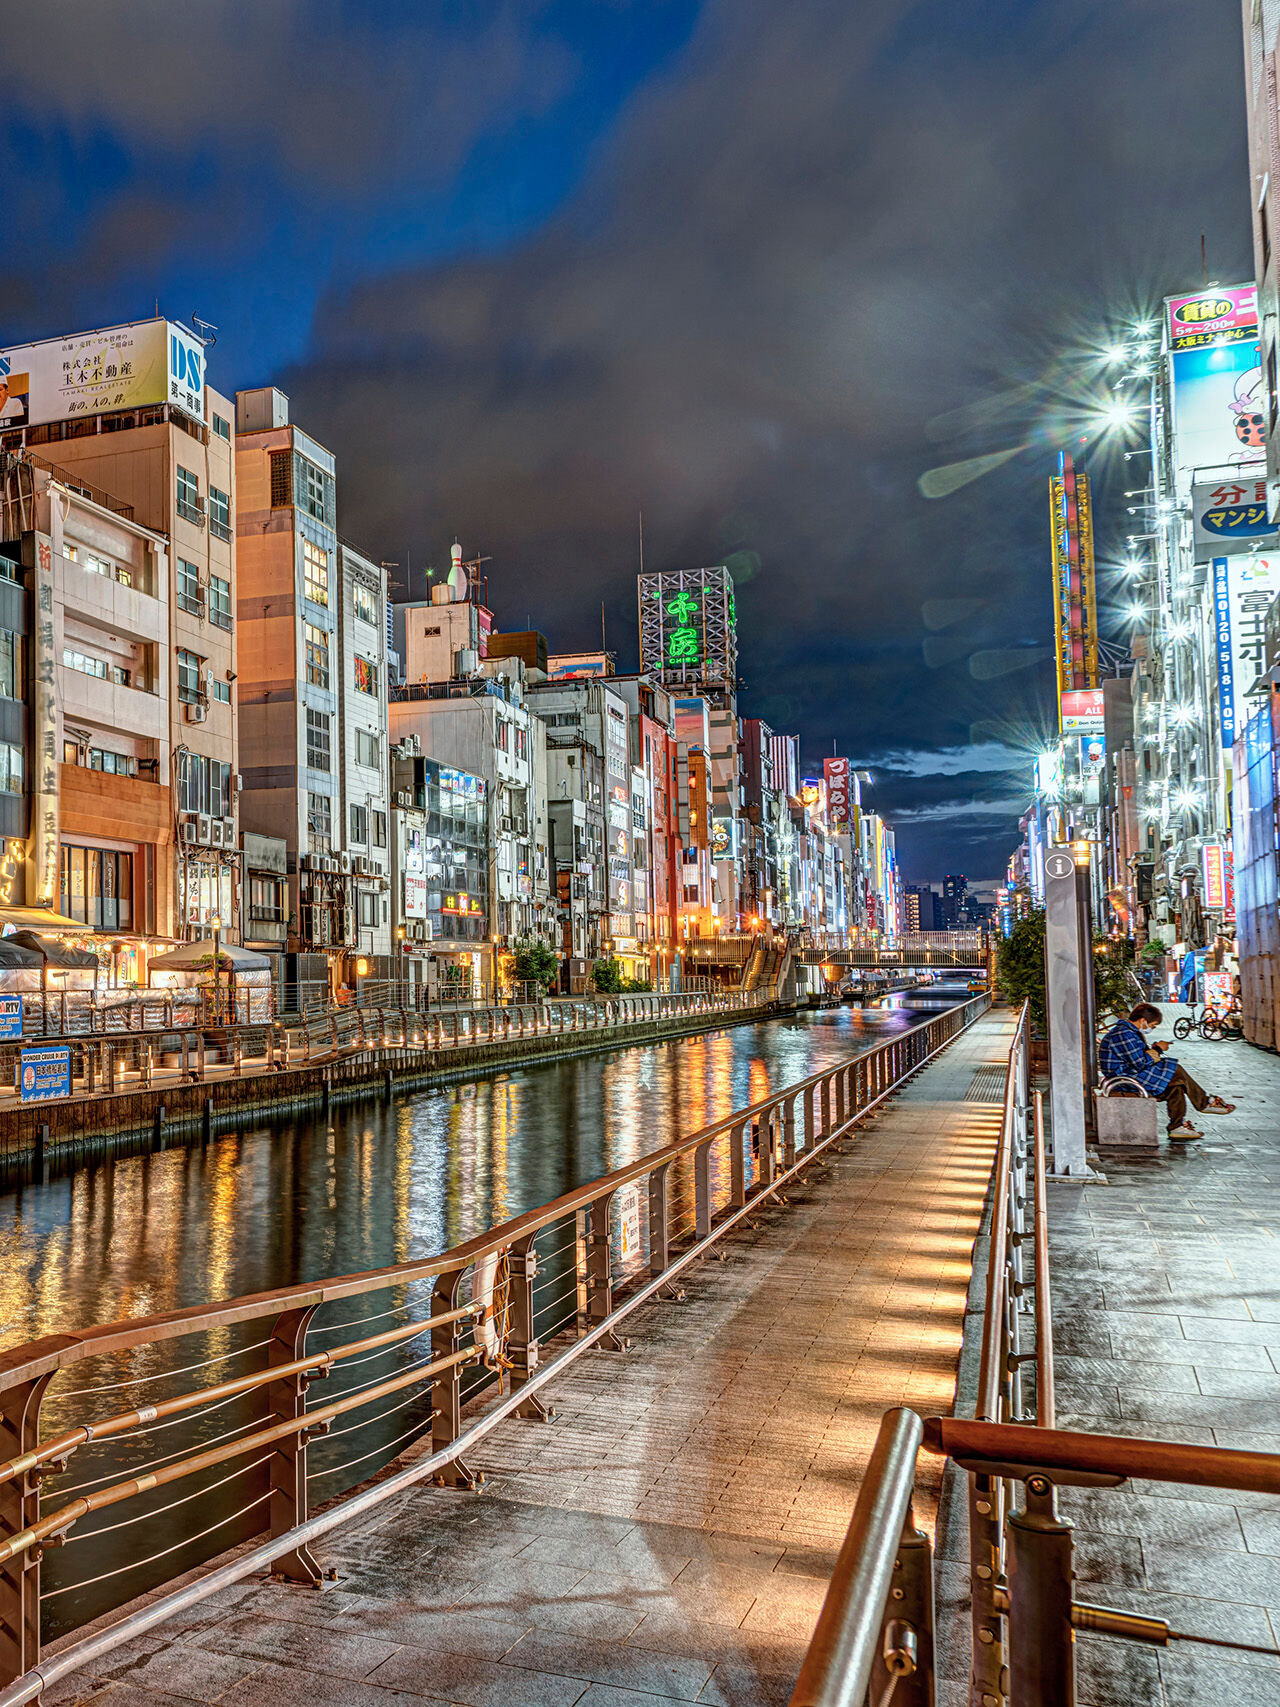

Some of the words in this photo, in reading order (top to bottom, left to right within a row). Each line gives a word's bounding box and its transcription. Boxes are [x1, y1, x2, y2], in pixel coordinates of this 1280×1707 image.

[63, 355, 102, 371] 株式会社
[62, 362, 133, 387] 玉木不動産
